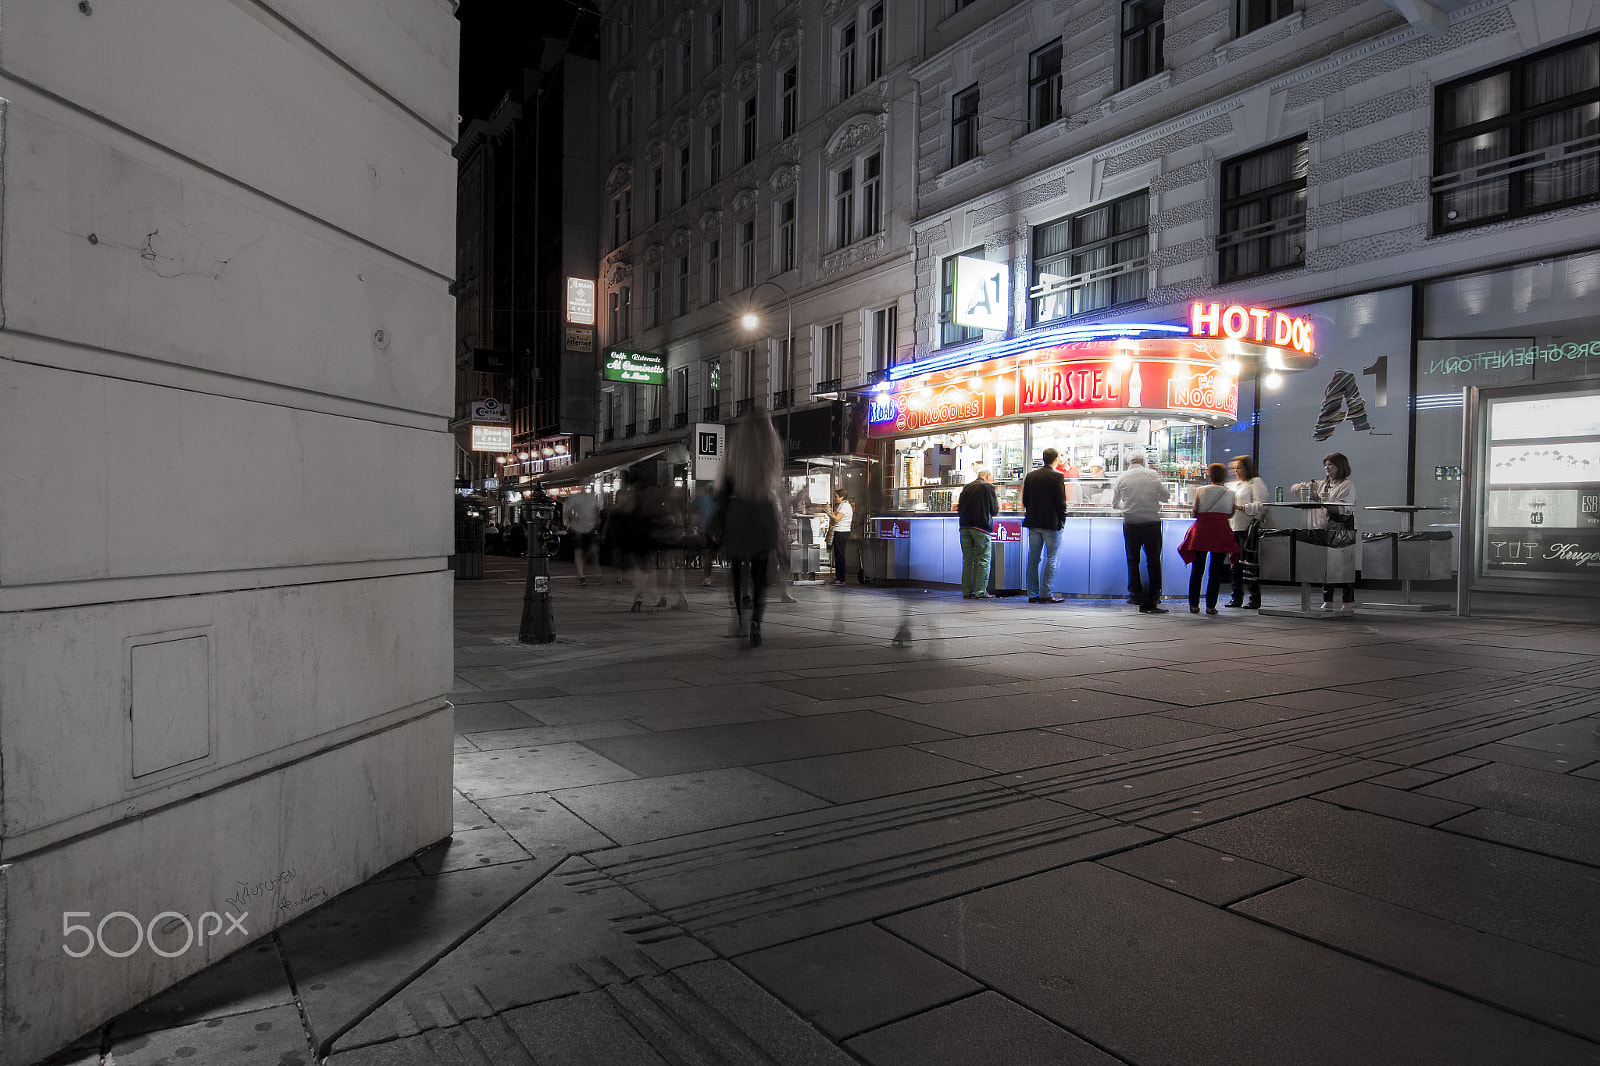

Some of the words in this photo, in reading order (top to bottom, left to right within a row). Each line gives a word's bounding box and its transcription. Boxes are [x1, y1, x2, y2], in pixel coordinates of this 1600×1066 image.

[966, 272, 1001, 315] A1
[1192, 302, 1271, 341] HOT
[1275, 312, 1312, 353] DOG
[923, 400, 979, 424] NOODLES
[1313, 355, 1388, 441] A1
[701, 435, 715, 453] UE
[1543, 543, 1600, 566] Kruge
